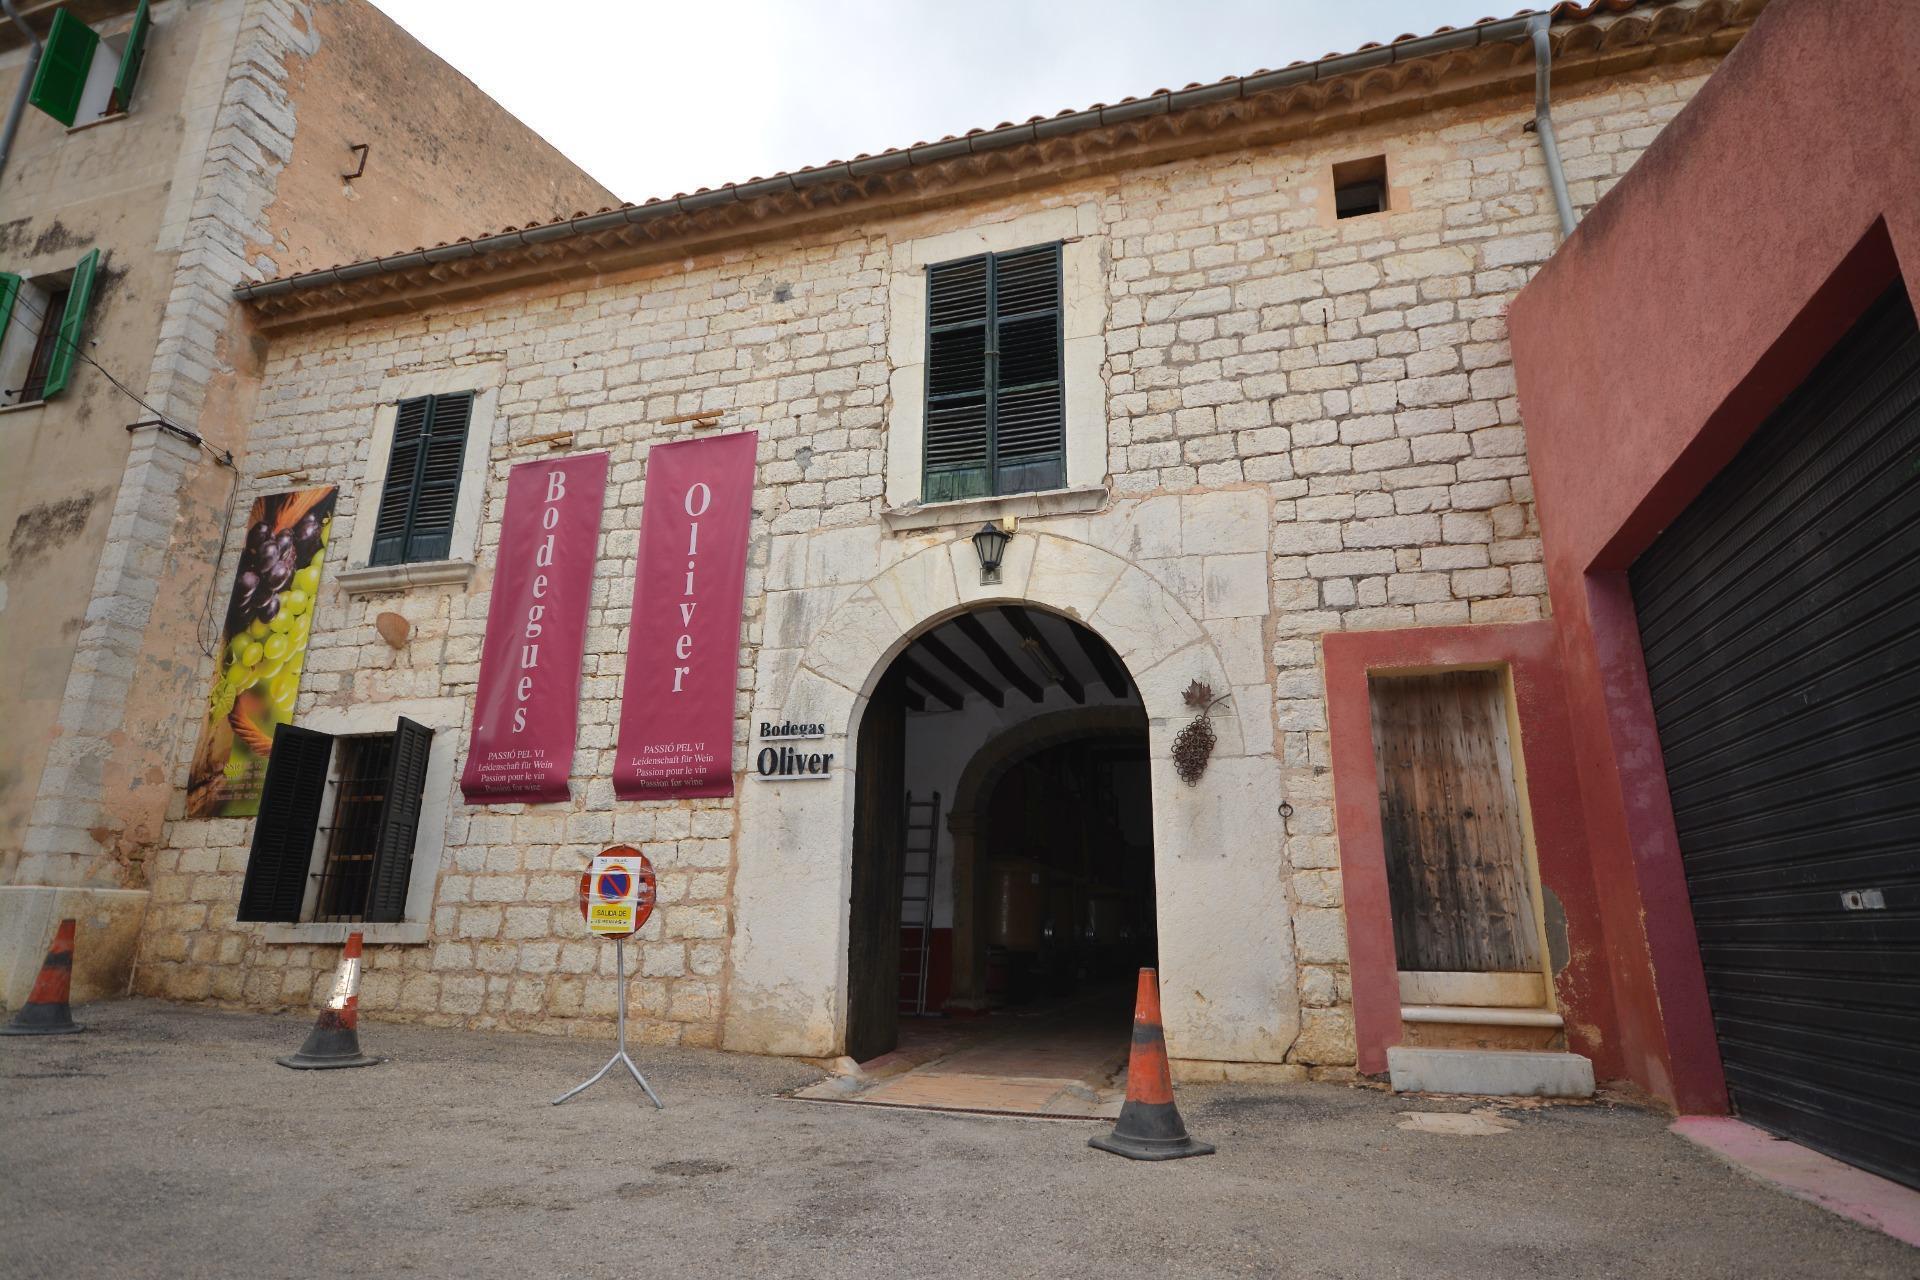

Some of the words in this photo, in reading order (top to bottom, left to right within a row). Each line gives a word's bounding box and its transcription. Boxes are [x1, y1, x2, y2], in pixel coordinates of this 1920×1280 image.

[672, 483, 711, 692] Oliver
[512, 471, 566, 734] Bodegues
[760, 721, 825, 737] Bodegas
[487, 748, 516, 760] PASSIÓ
[517, 750, 532, 759] PEL
[534, 749, 545, 758] VI
[643, 742, 675, 754] PASSIÓ
[676, 743, 693, 752] PEL
[694, 742, 705, 751] VI
[478, 761, 520, 772] Leidenschaft
[521, 761, 531, 770] für
[533, 760, 553, 769] Wein
[632, 756, 680, 766] Leidenschaft
[680, 754, 693, 764] für
[694, 753, 714, 763] Wein
[757, 747, 834, 776] Oliver
[481, 773, 506, 782] Passion
[507, 774, 524, 784] pour
[525, 771, 532, 780] le
[533, 771, 545, 780] vin
[636, 768, 664, 777] Passion
[665, 768, 684, 778] pour
[685, 766, 693, 775] le
[694, 765, 707, 774] vin
[640, 779, 669, 788] Passion
[670, 778, 682, 787] for
[683, 777, 704, 786] wine
[597, 909, 617, 917] SALIDA
